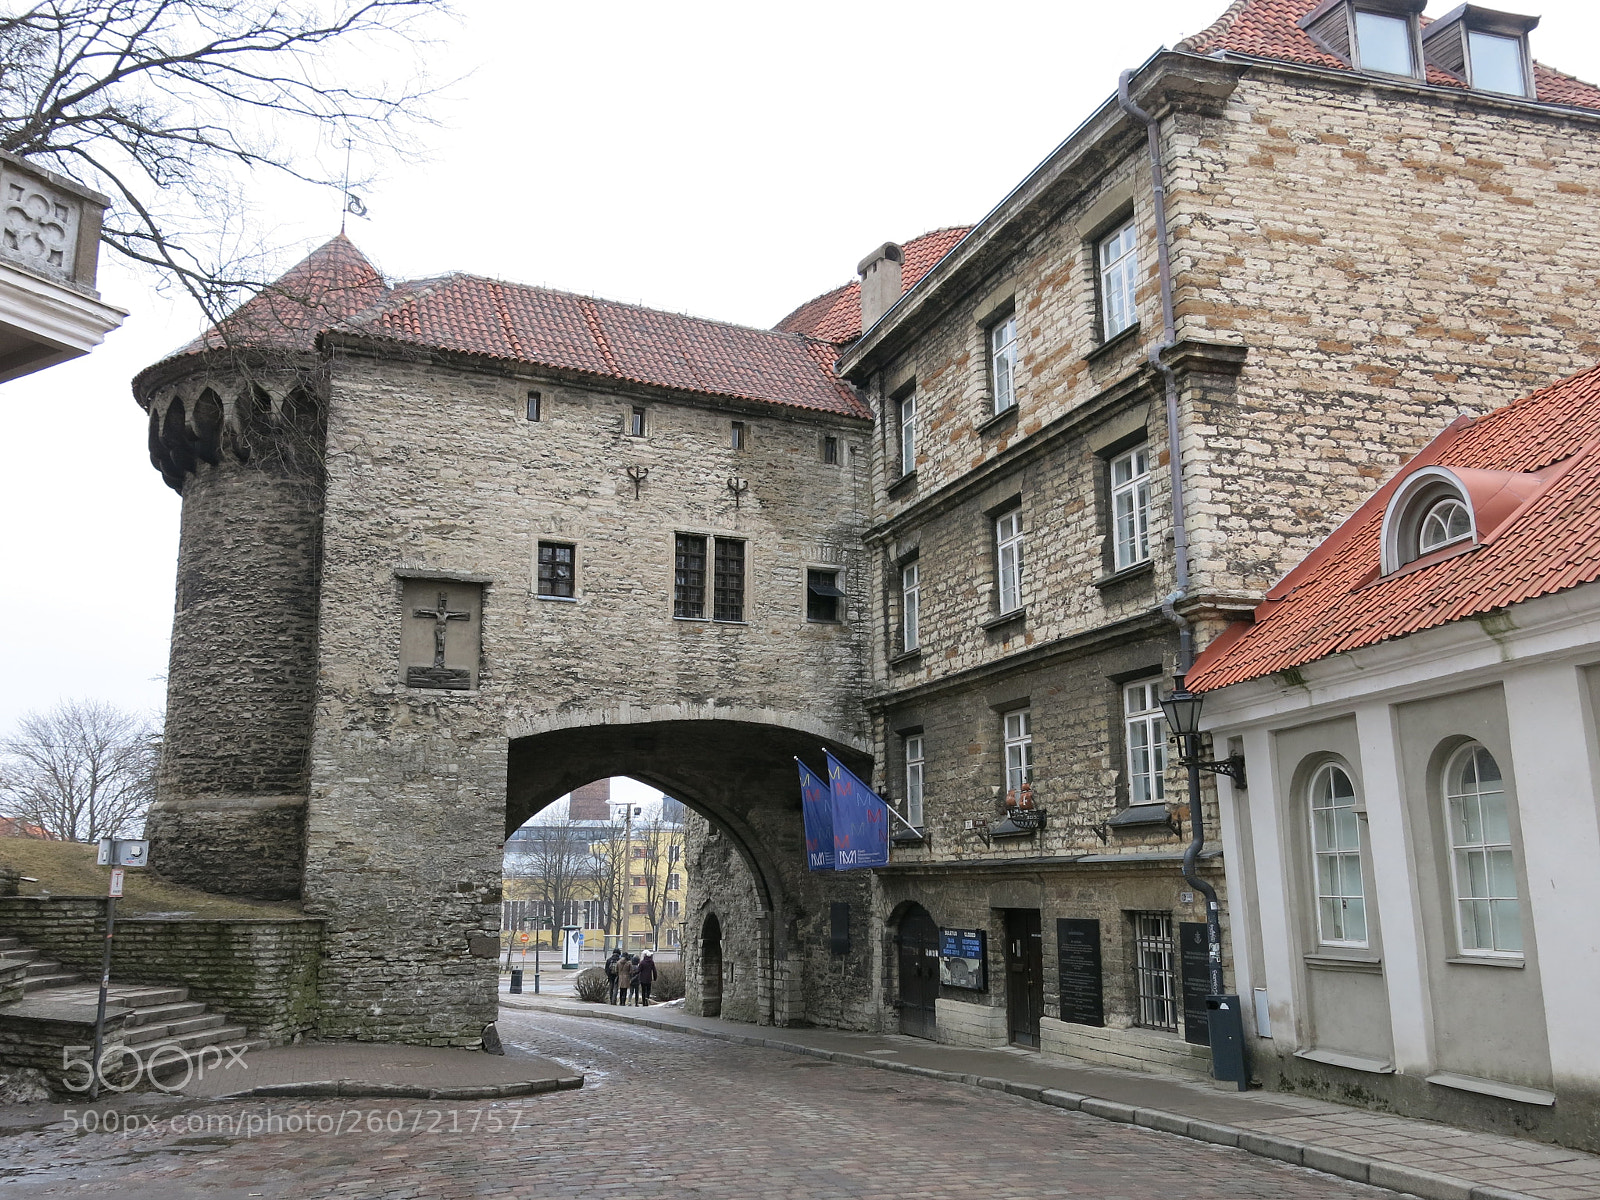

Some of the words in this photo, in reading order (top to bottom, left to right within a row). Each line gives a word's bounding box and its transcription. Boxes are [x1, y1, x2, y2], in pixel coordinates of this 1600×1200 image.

[836, 782, 852, 797] M
[856, 792, 872, 807] M
[867, 808, 882, 823] M
[834, 834, 850, 849] M
